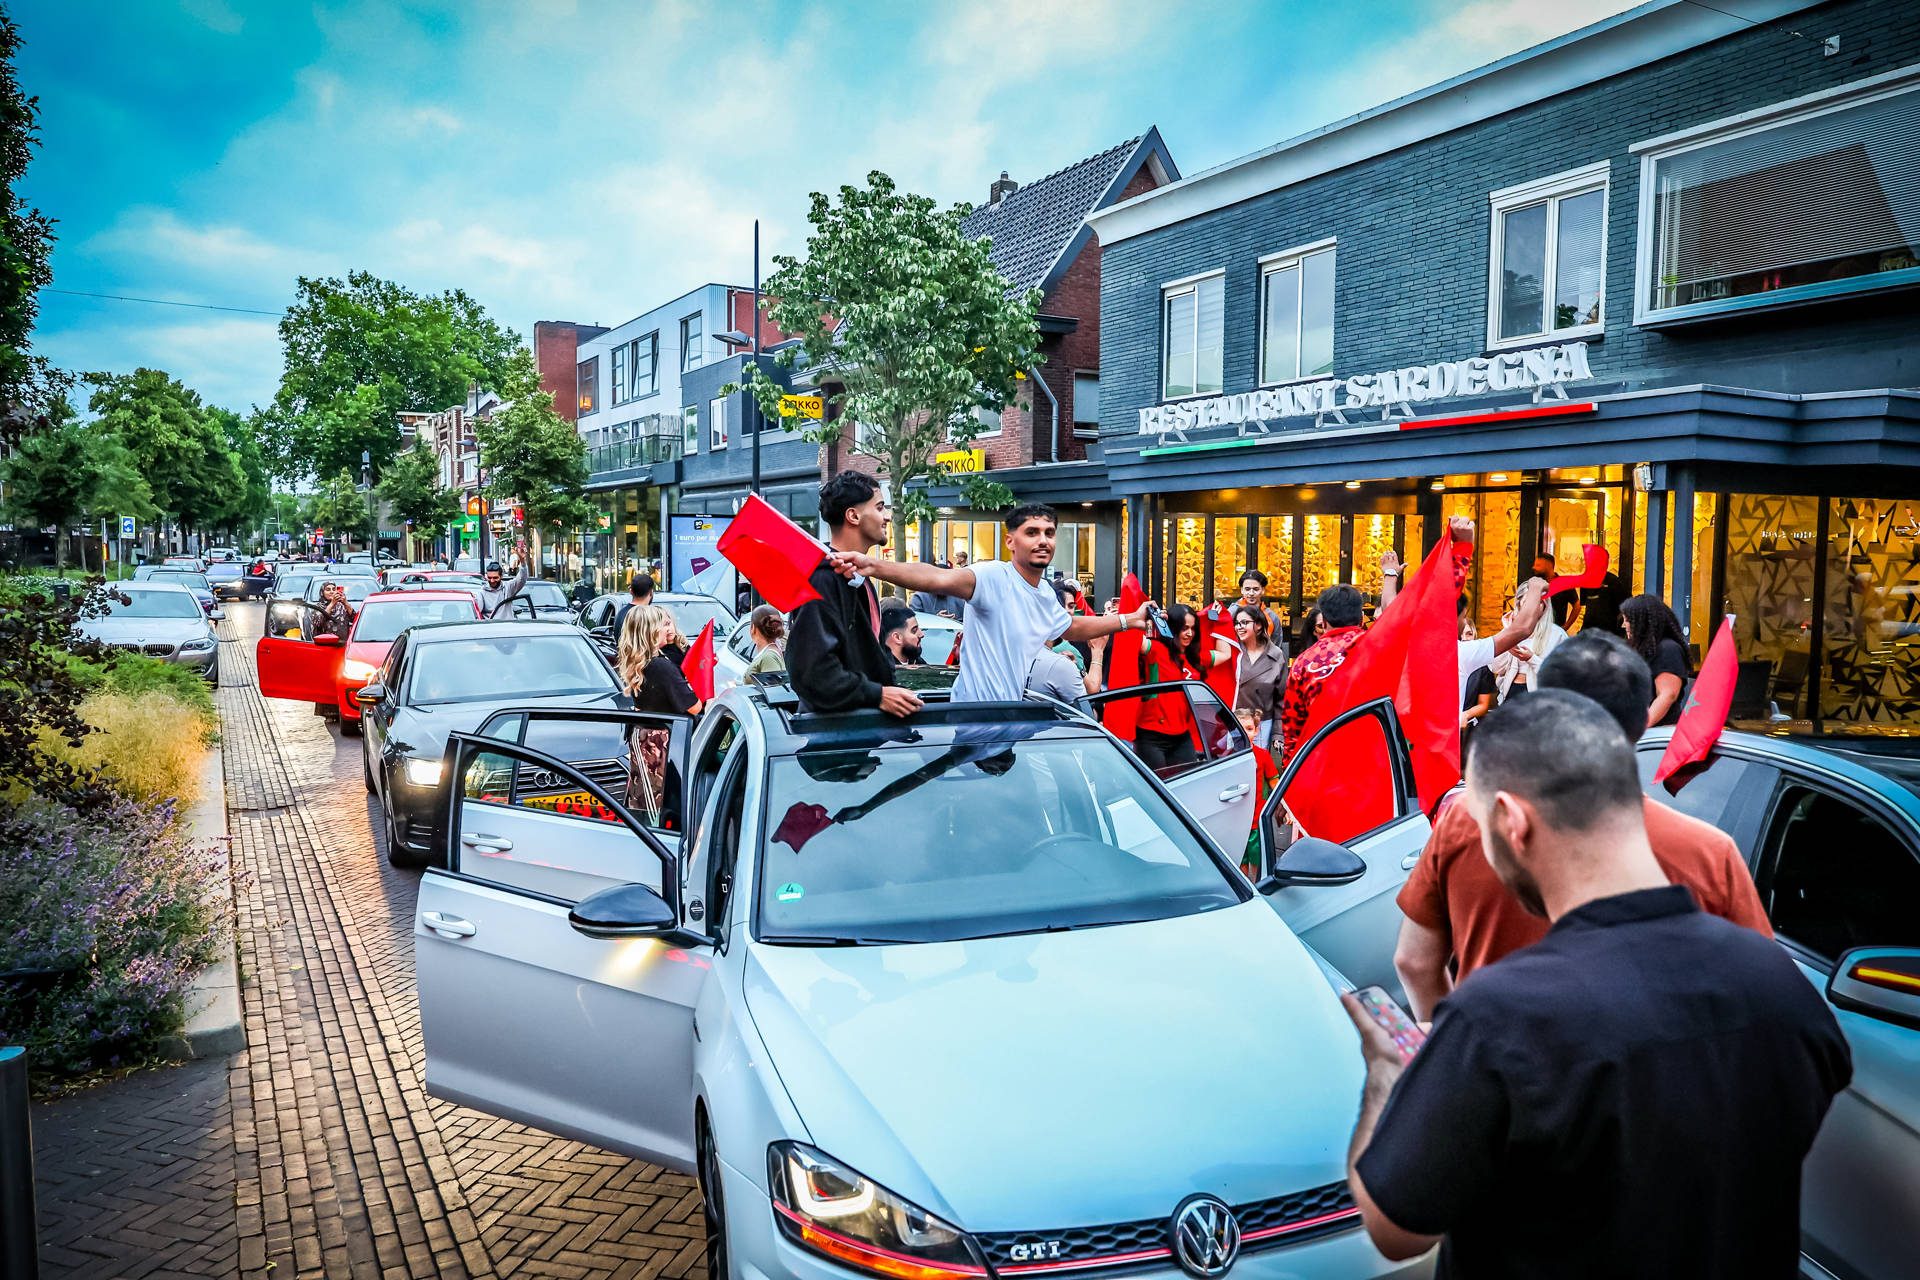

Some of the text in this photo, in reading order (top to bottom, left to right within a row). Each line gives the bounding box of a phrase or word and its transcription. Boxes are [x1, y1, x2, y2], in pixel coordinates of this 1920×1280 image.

[1139, 342, 1594, 435] RESTAURANT SARDEGNA
[378, 530, 401, 538] STUDIO
[1182, 667, 1193, 680] 2
[1010, 1240, 1061, 1262] GTI
